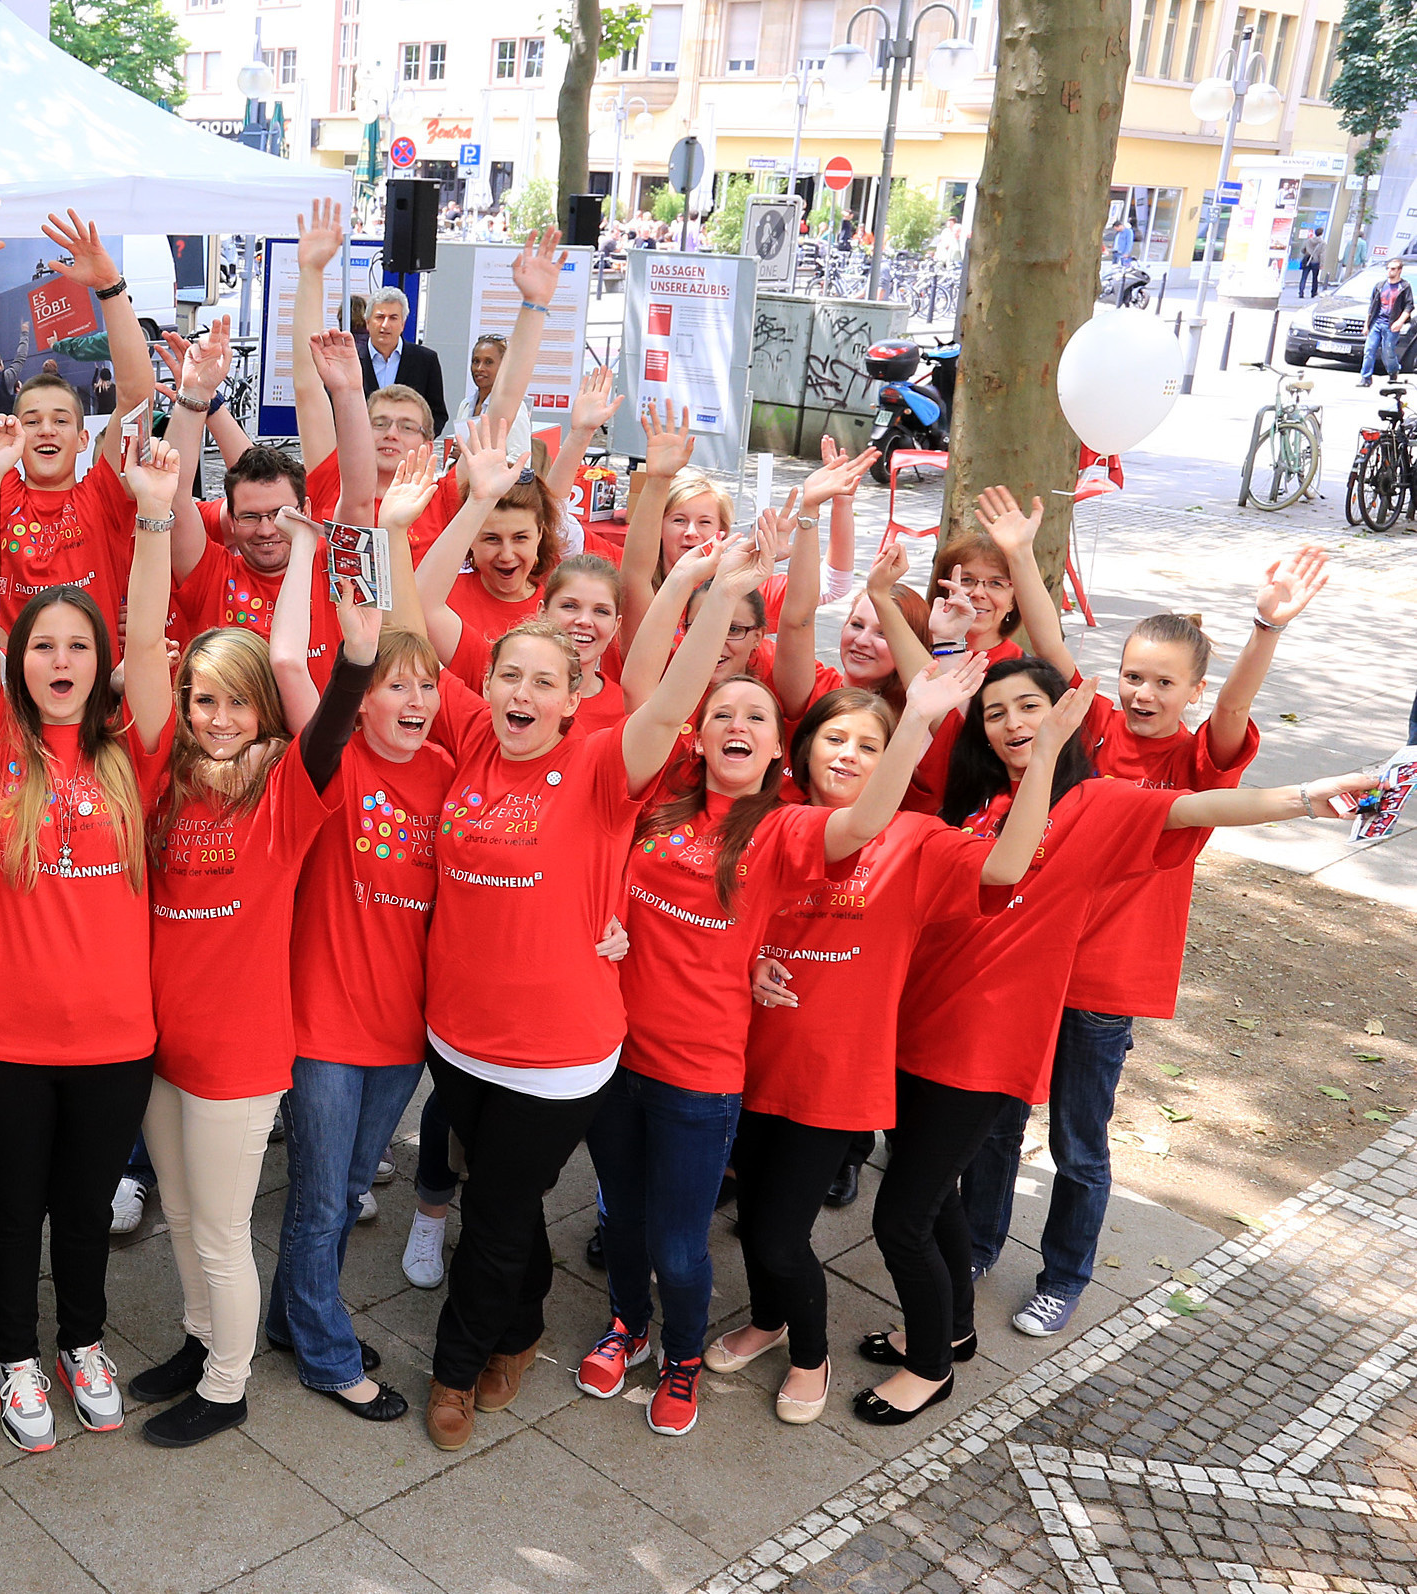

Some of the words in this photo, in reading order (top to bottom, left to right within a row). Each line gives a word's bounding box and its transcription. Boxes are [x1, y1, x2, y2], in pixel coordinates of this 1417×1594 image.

[651, 264, 670, 276] DAS
[672, 265, 705, 278] SAGEN
[759, 265, 777, 277] ONE
[650, 281, 687, 293] UNSERE
[689, 284, 730, 296] AZUBIS:
[32, 290, 46, 306] ES
[34, 297, 71, 321] TOBT.
[200, 848, 236, 862] 2013
[829, 893, 866, 908] 2013
